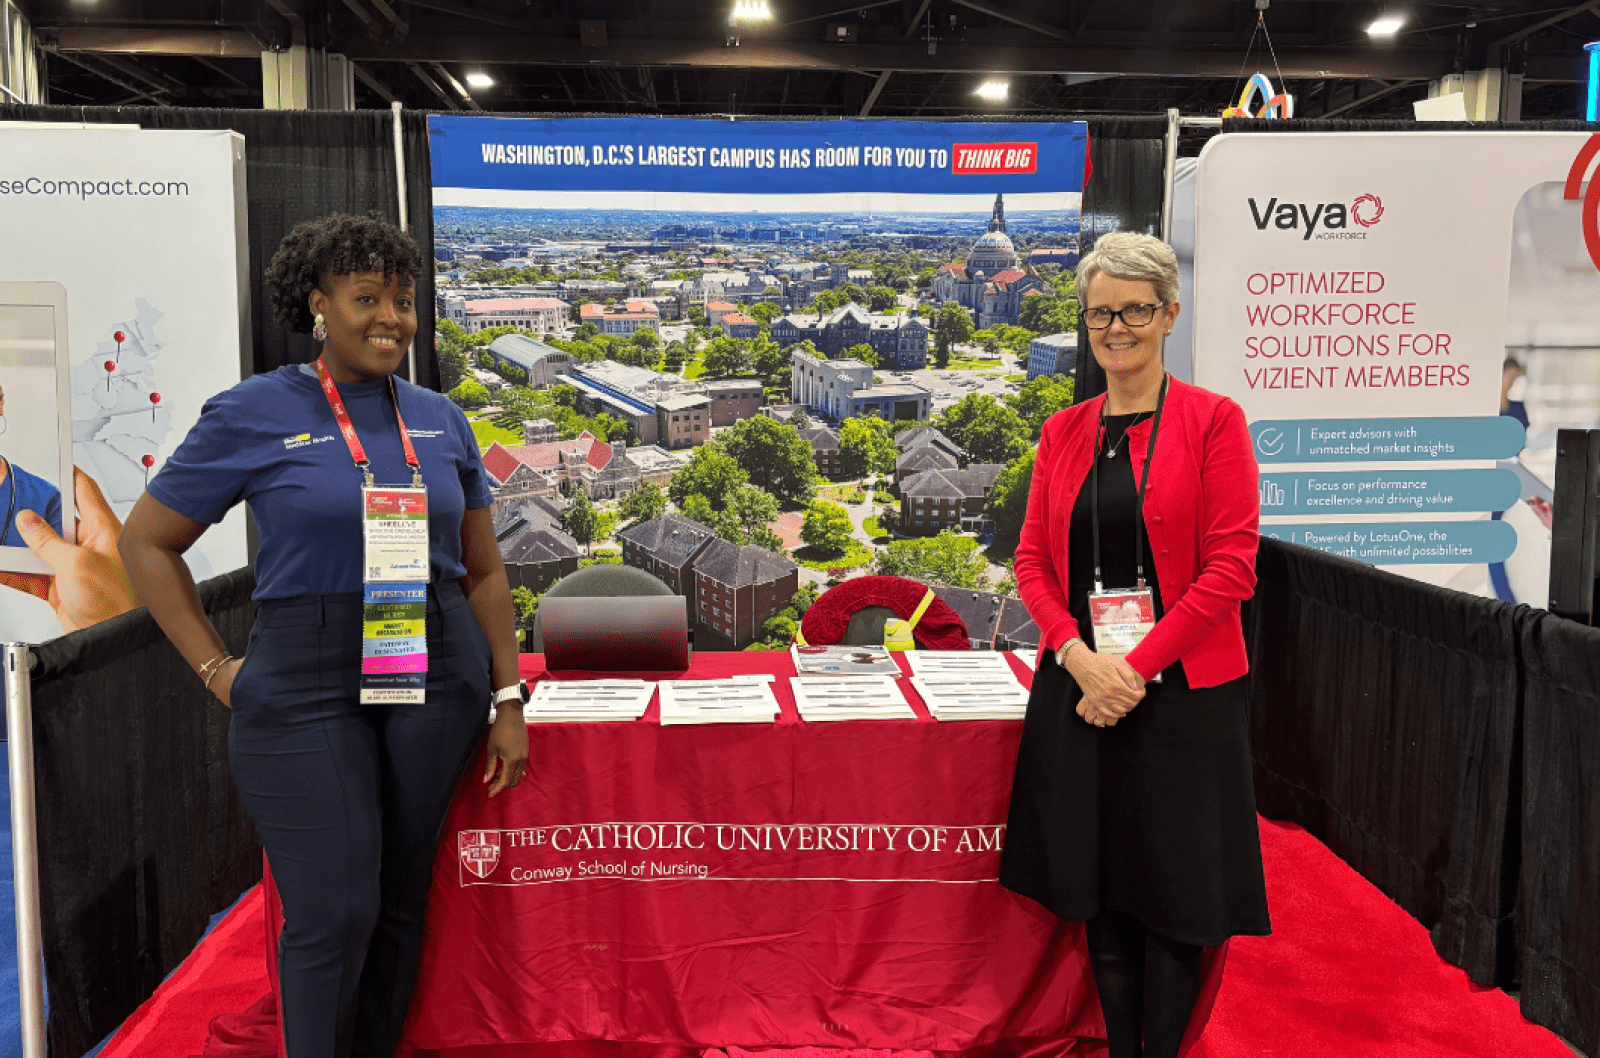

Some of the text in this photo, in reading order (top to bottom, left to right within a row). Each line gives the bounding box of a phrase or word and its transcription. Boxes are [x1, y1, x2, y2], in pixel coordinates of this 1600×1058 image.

[481, 143, 947, 169] WASHINGTON, D.C.'S LARGEST CAMPUS HAS ROOM FOR YOU TO
[957, 149, 1032, 169] THINK BIG
[1247, 197, 1348, 241] Vaya
[1314, 232, 1368, 241] WORKFORCE
[1246, 271, 1385, 296] OPTIMIZED
[1246, 302, 1416, 327] WORKFORCE
[1245, 333, 1452, 358] SOLUTIONS FOR
[1243, 364, 1471, 390] VIZIENT MEMBERS
[1310, 425, 1417, 443] Expert advisors with
[1309, 440, 1455, 457] unmatched market insights
[1307, 477, 1427, 494] Focus on performance
[1306, 491, 1454, 508] excellence and driving value
[1305, 529, 1447, 546] Powered by LotusOne, the
[1335, 545, 1358, 558] with
[1359, 544, 1411, 557] unlimited
[1412, 543, 1474, 560] possibilities
[370, 590, 424, 598] PRESENTER
[506, 824, 1007, 853] THE CATHOLIC UNIVERSITY OF AM
[510, 860, 708, 882] Conway School of Nursing
